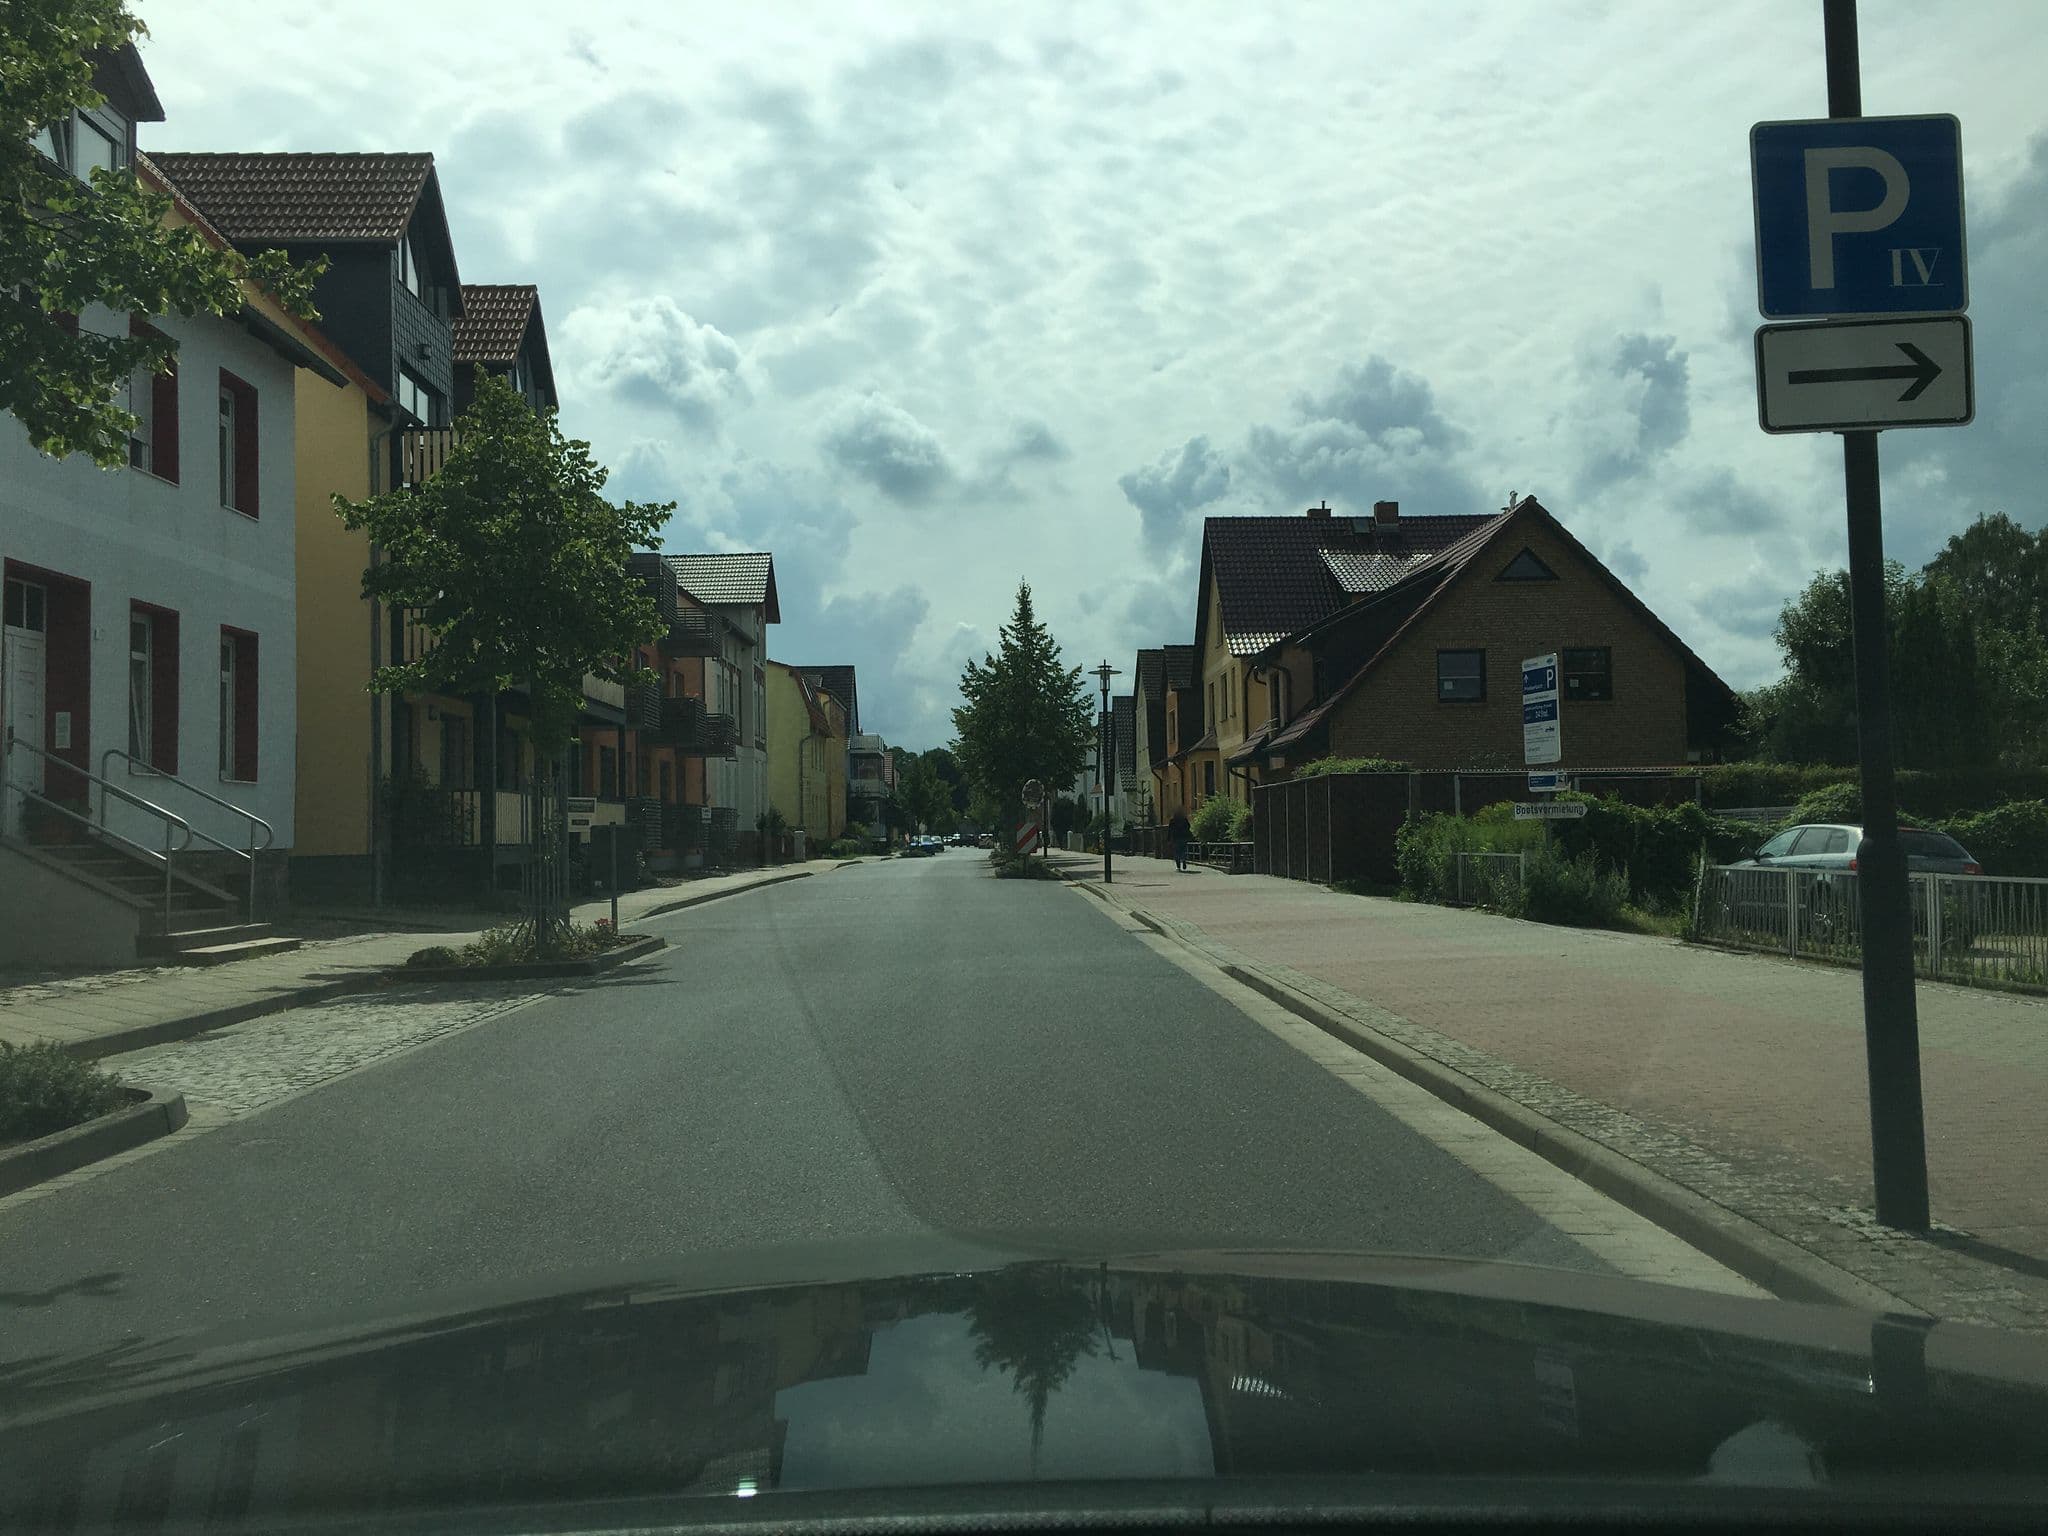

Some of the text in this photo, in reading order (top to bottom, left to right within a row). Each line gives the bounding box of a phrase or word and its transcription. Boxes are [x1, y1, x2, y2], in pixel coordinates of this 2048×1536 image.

[1804, 147, 1944, 289] P IV
[1546, 669, 1554, 689] P
[1515, 803, 1584, 816] Bootsvermietung
